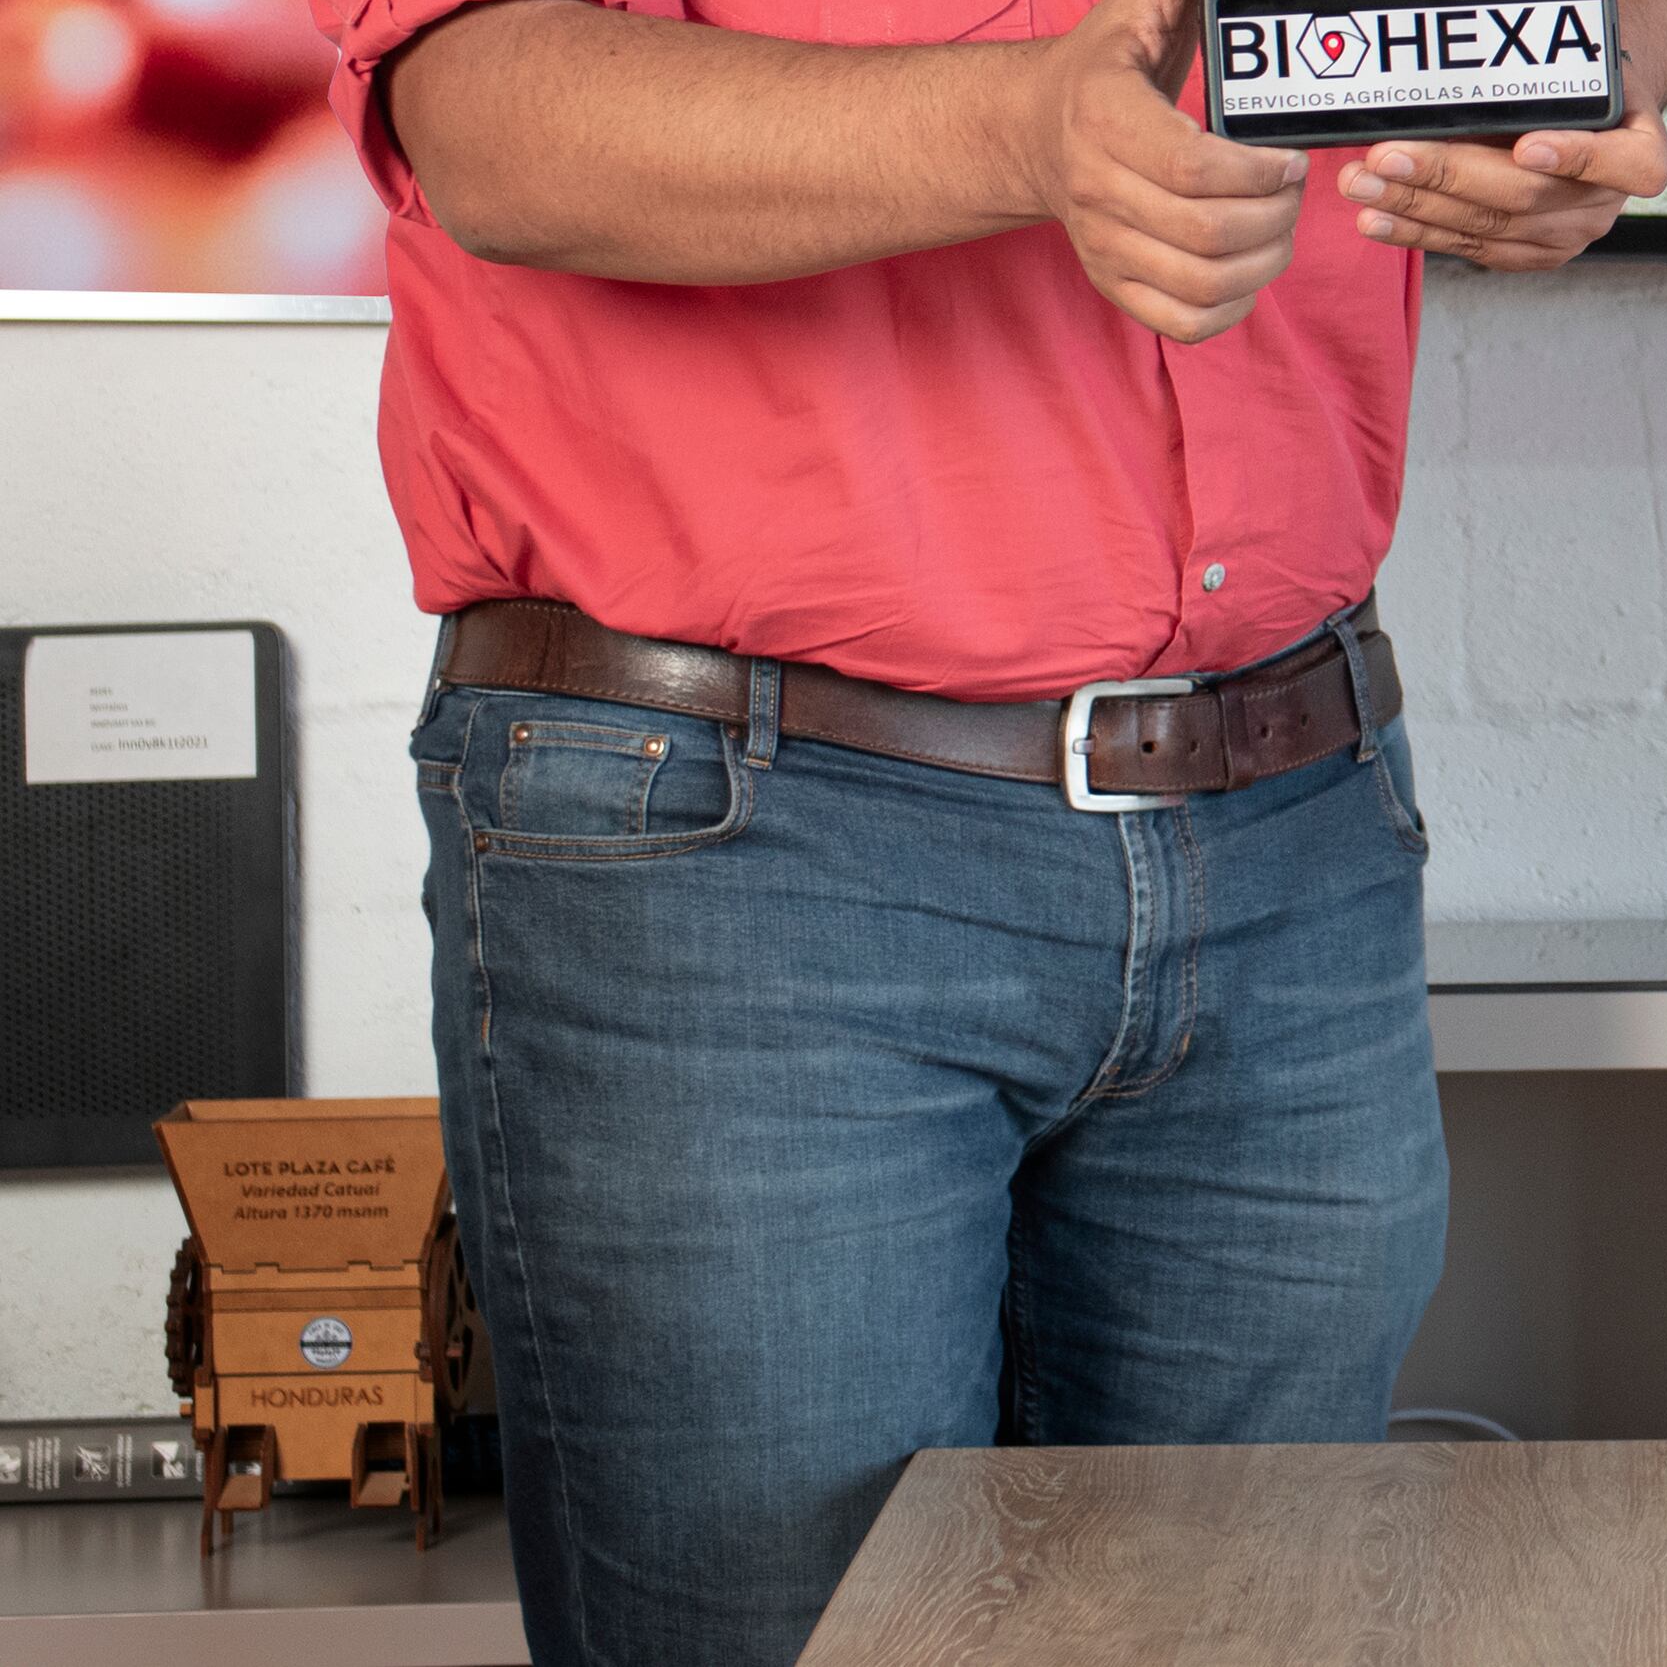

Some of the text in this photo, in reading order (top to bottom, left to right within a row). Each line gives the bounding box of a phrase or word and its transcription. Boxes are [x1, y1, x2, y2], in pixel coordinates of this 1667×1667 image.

[1225, 78, 1602, 111] SERVICIOS AGRÍCOLAS A DOMICILIO
[223, 1154, 396, 1177] LOTE PLAZA CAFÉ
[241, 1183, 319, 1199] Variedad
[234, 1205, 389, 1221] Altura 1370 msnm
[251, 1385, 384, 1408] HONDURAS
